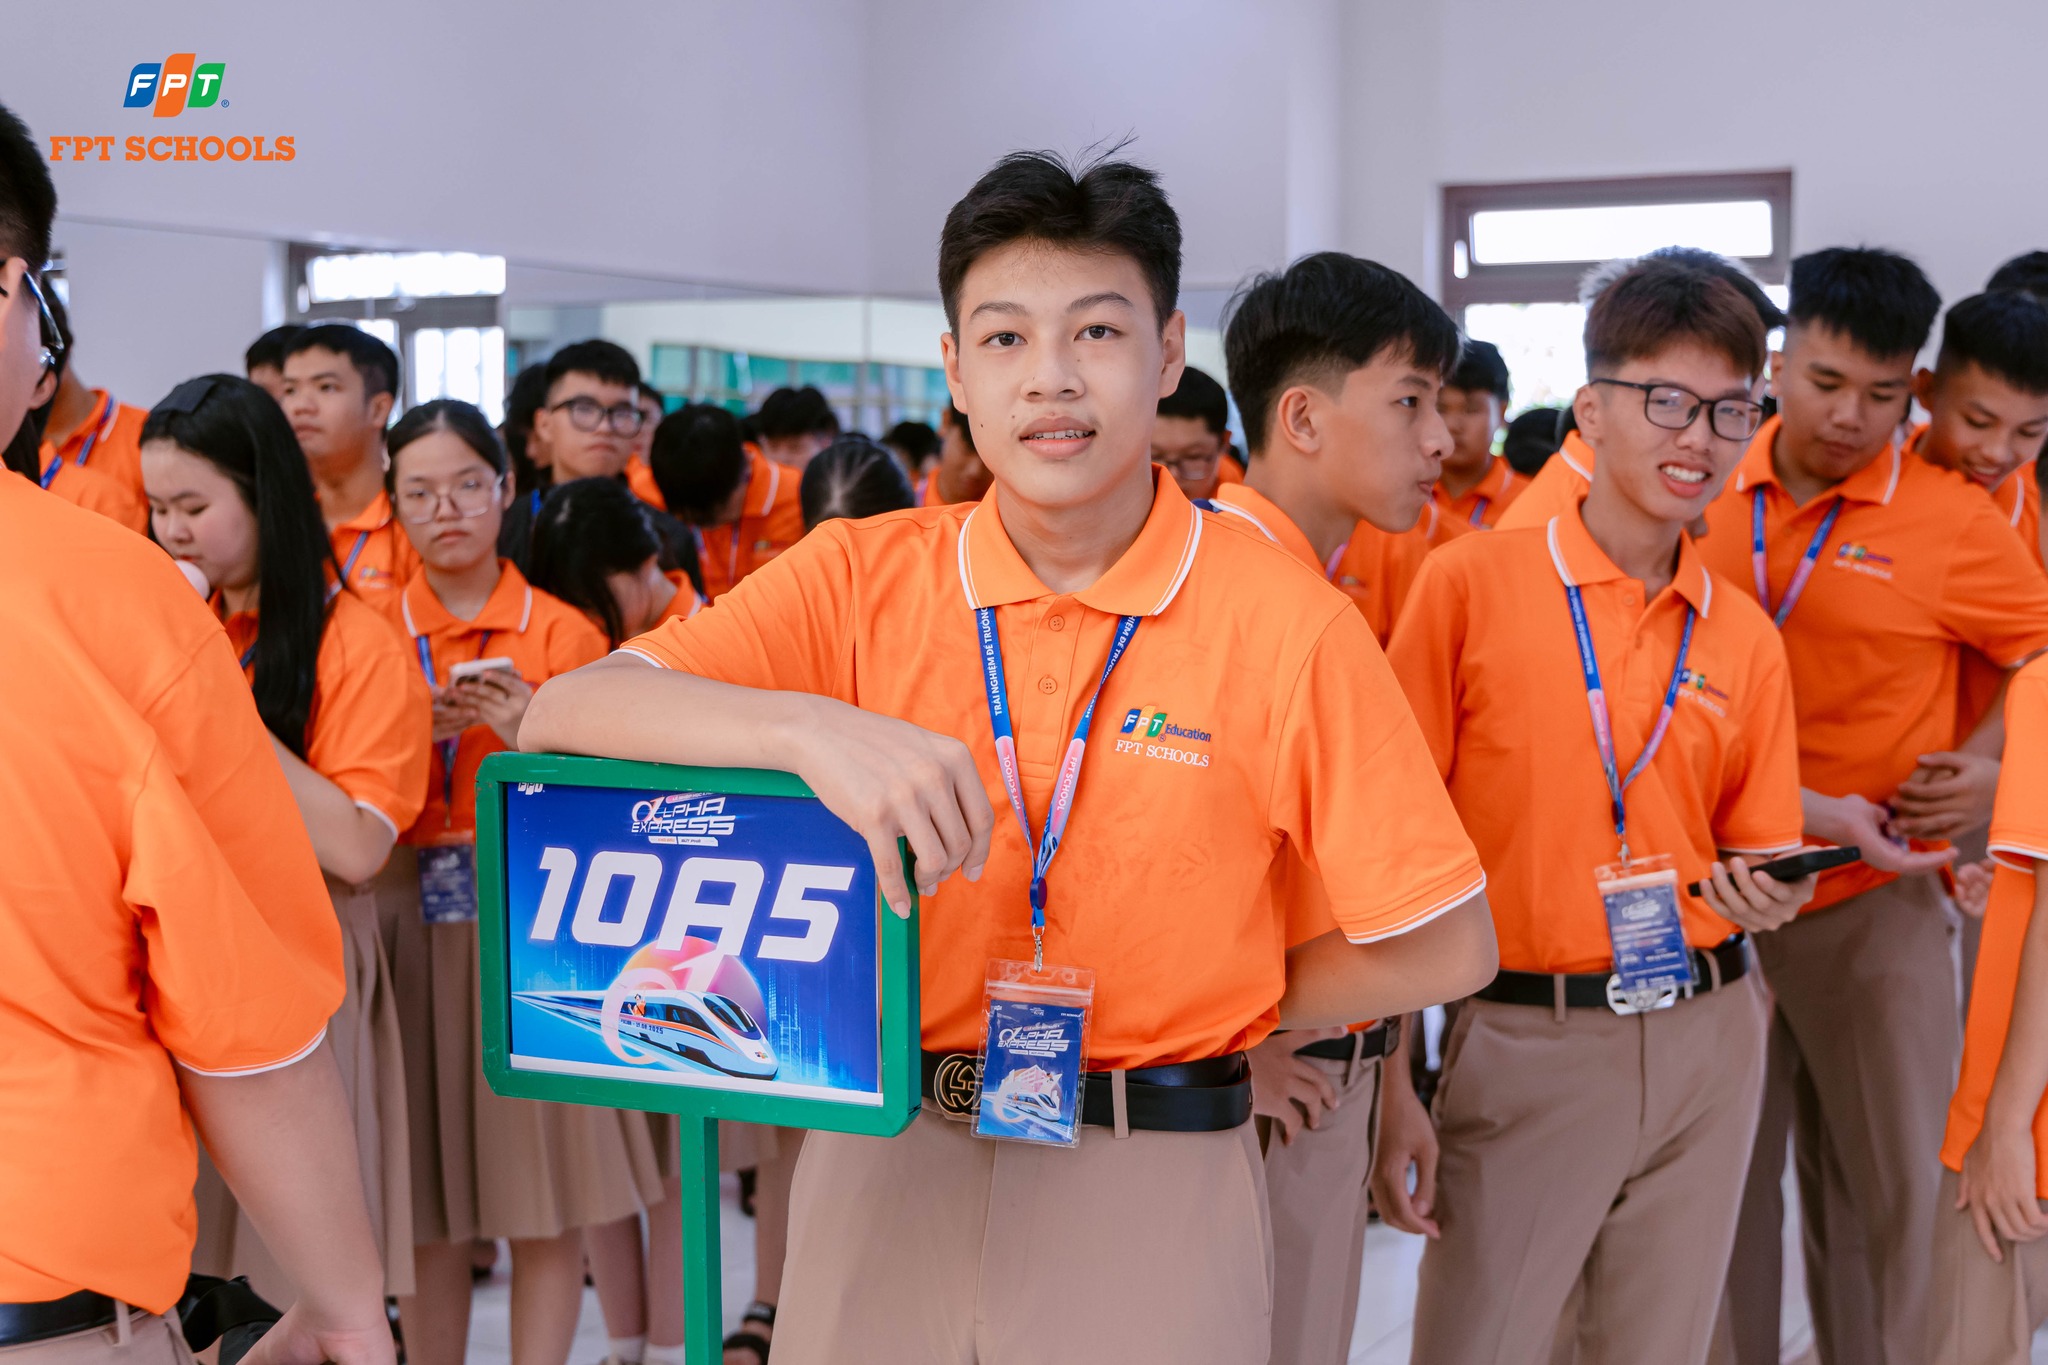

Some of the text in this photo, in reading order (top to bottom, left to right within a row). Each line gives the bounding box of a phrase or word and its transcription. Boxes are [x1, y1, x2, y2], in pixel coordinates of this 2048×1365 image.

[1165, 723, 1212, 742] Education
[1115, 739, 1210, 768] FPT SCHOOLS
[1057, 756, 1078, 811] FPT SCHOOL
[631, 815, 736, 836] EXPRESS
[530, 846, 856, 963] 10A5
[997, 1039, 1070, 1052] EXPRESS
